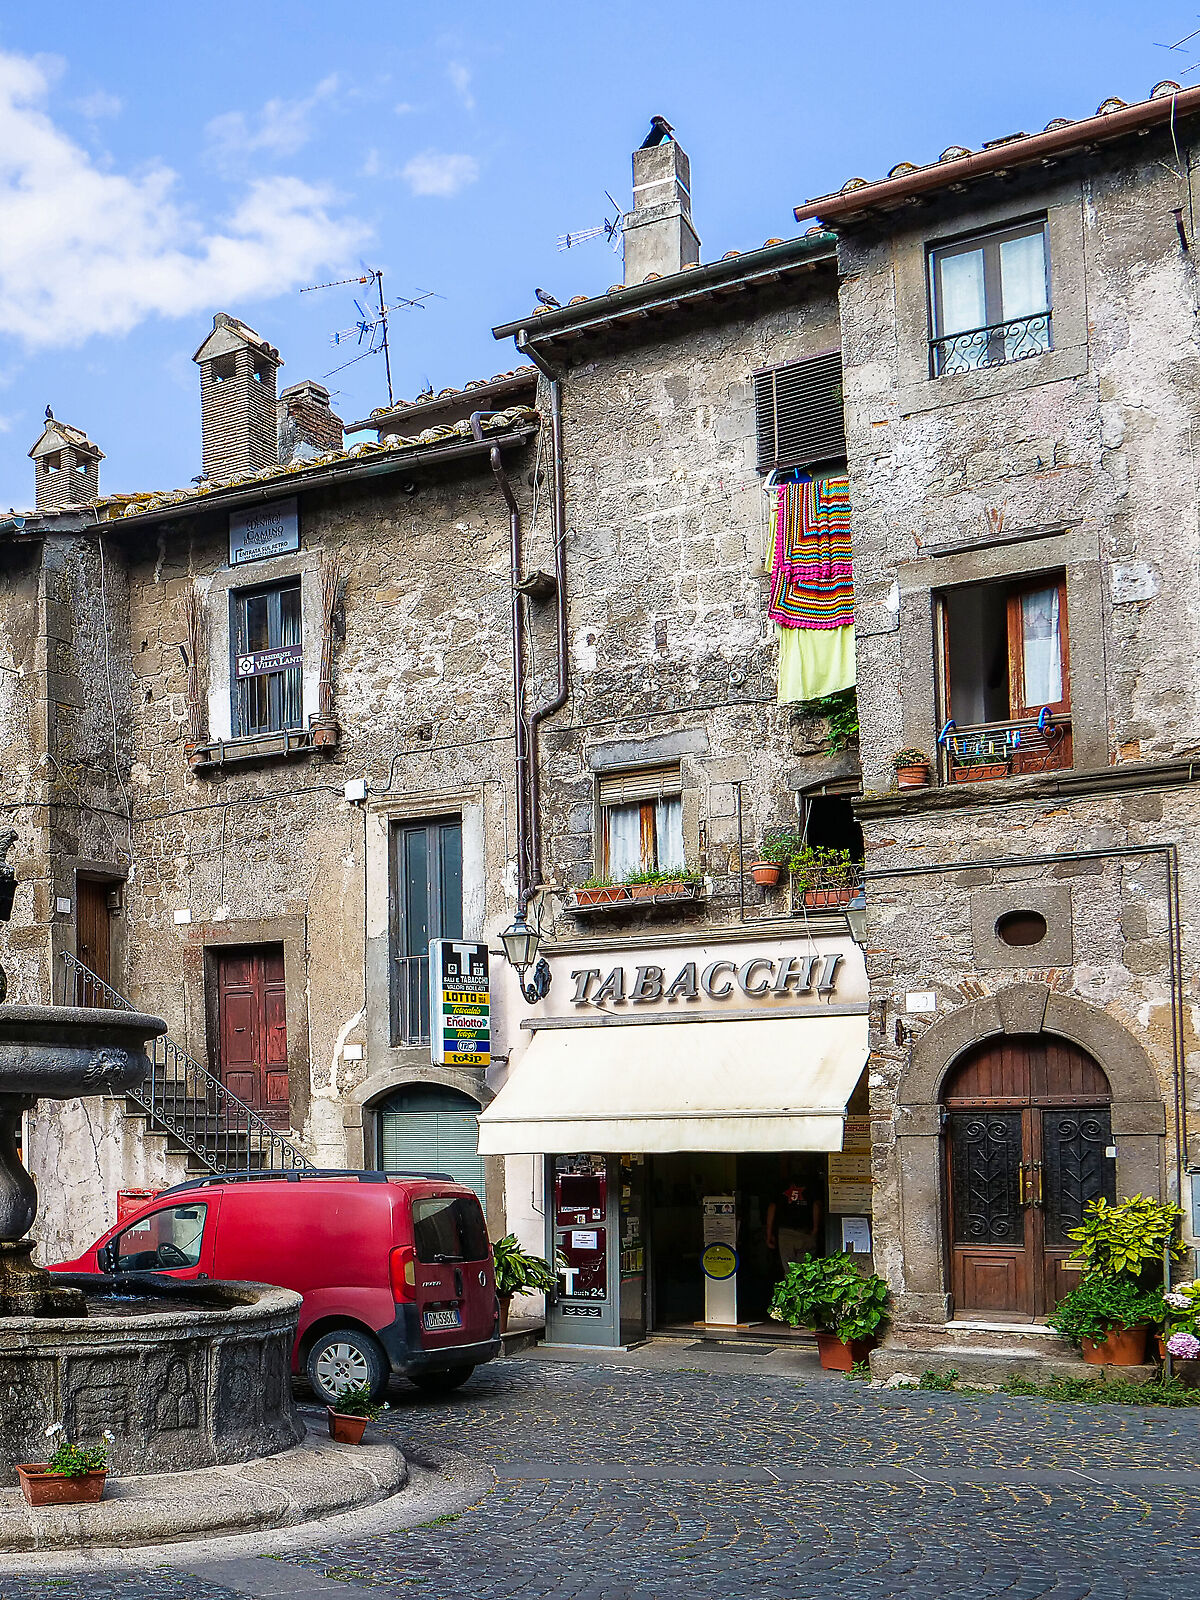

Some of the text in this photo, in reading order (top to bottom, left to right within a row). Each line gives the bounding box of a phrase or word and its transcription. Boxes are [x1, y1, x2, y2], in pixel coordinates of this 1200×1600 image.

[246, 526, 284, 541] CAMINO
[255, 659, 279, 670] VILLA
[460, 976, 488, 984] TABACCHI
[570, 953, 844, 1003] TABACCHI
[446, 992, 477, 1002] LOTTO
[446, 1017, 482, 1027] Enalotto
[452, 1054, 482, 1063] totip
[791, 1190, 799, 1201] 5
